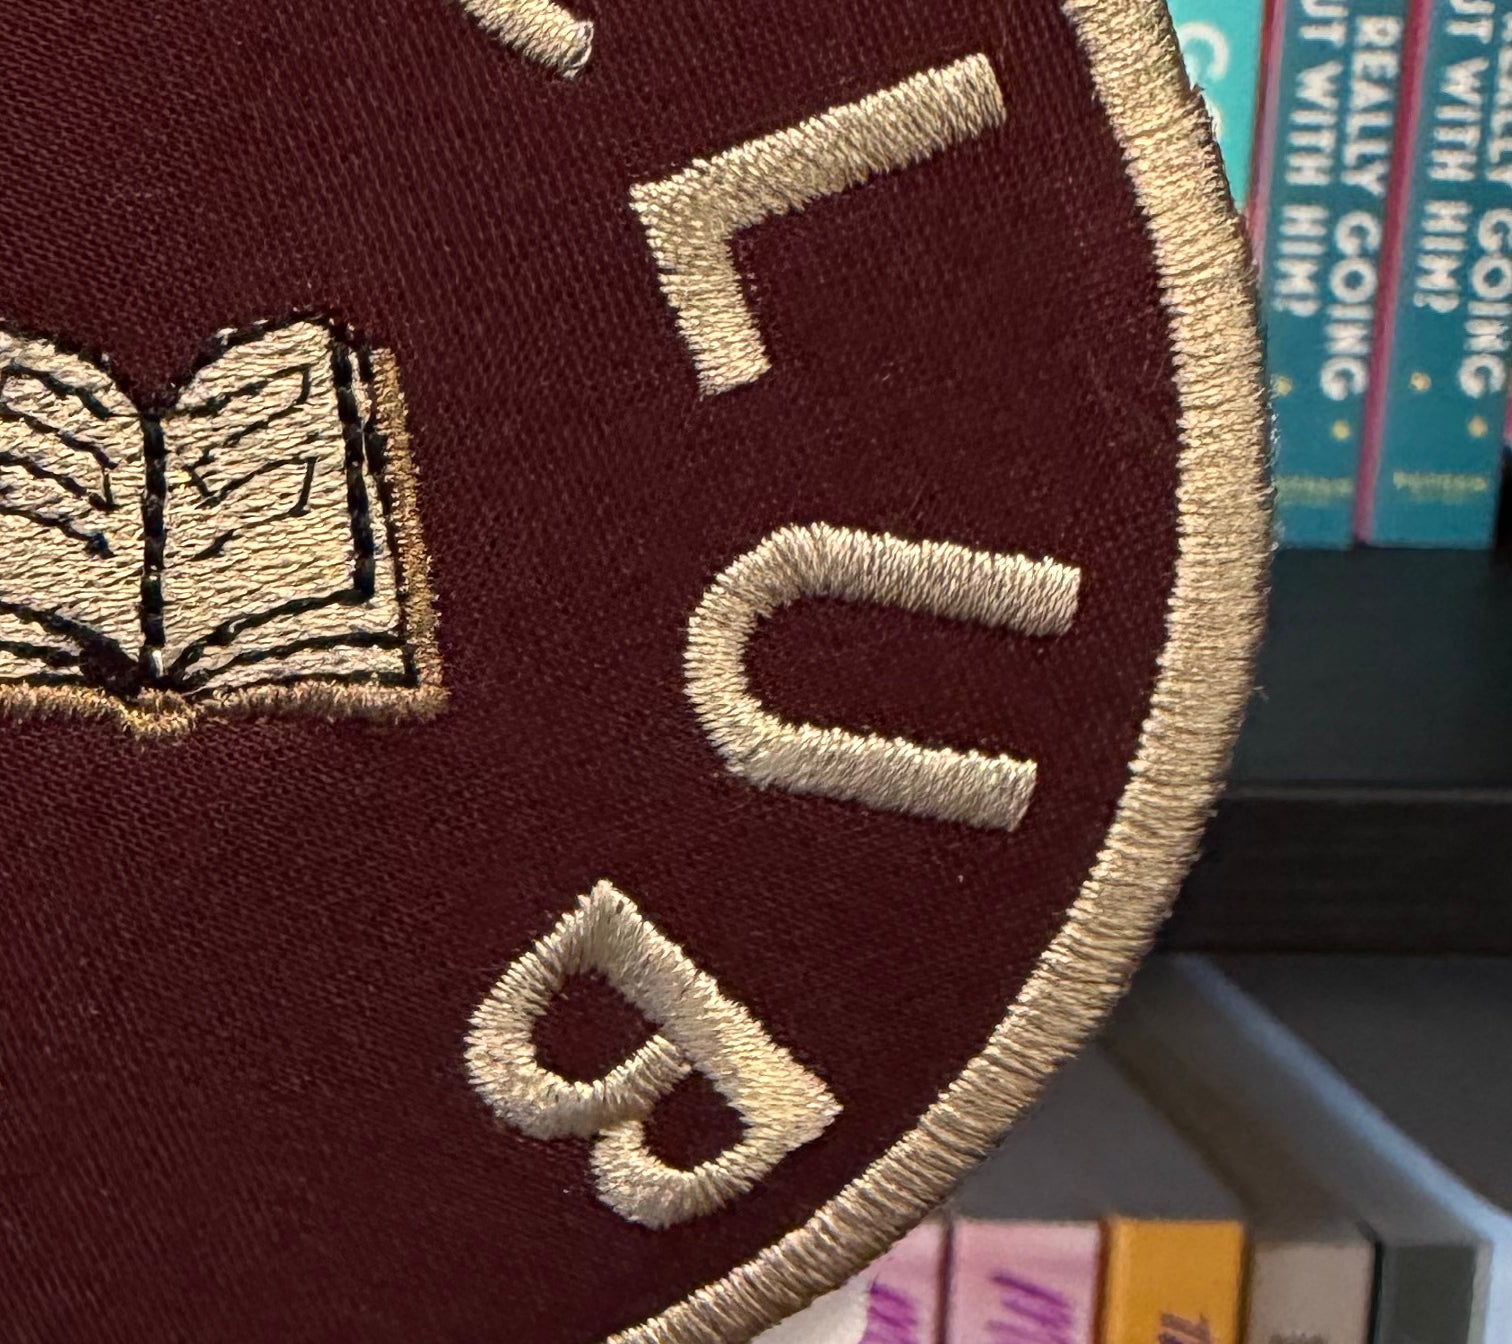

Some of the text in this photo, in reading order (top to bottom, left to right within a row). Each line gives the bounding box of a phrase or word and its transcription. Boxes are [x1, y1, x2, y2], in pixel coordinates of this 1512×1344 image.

[1286, 62, 1345, 186] WITH
[1342, 15, 1404, 197] REALLY
[1429, 59, 1487, 183] WITH
[1274, 206, 1327, 318] HIM?
[1319, 211, 1381, 402] GOING
[1412, 200, 1471, 314] HIM?
[1457, 208, 1512, 398] GOING
